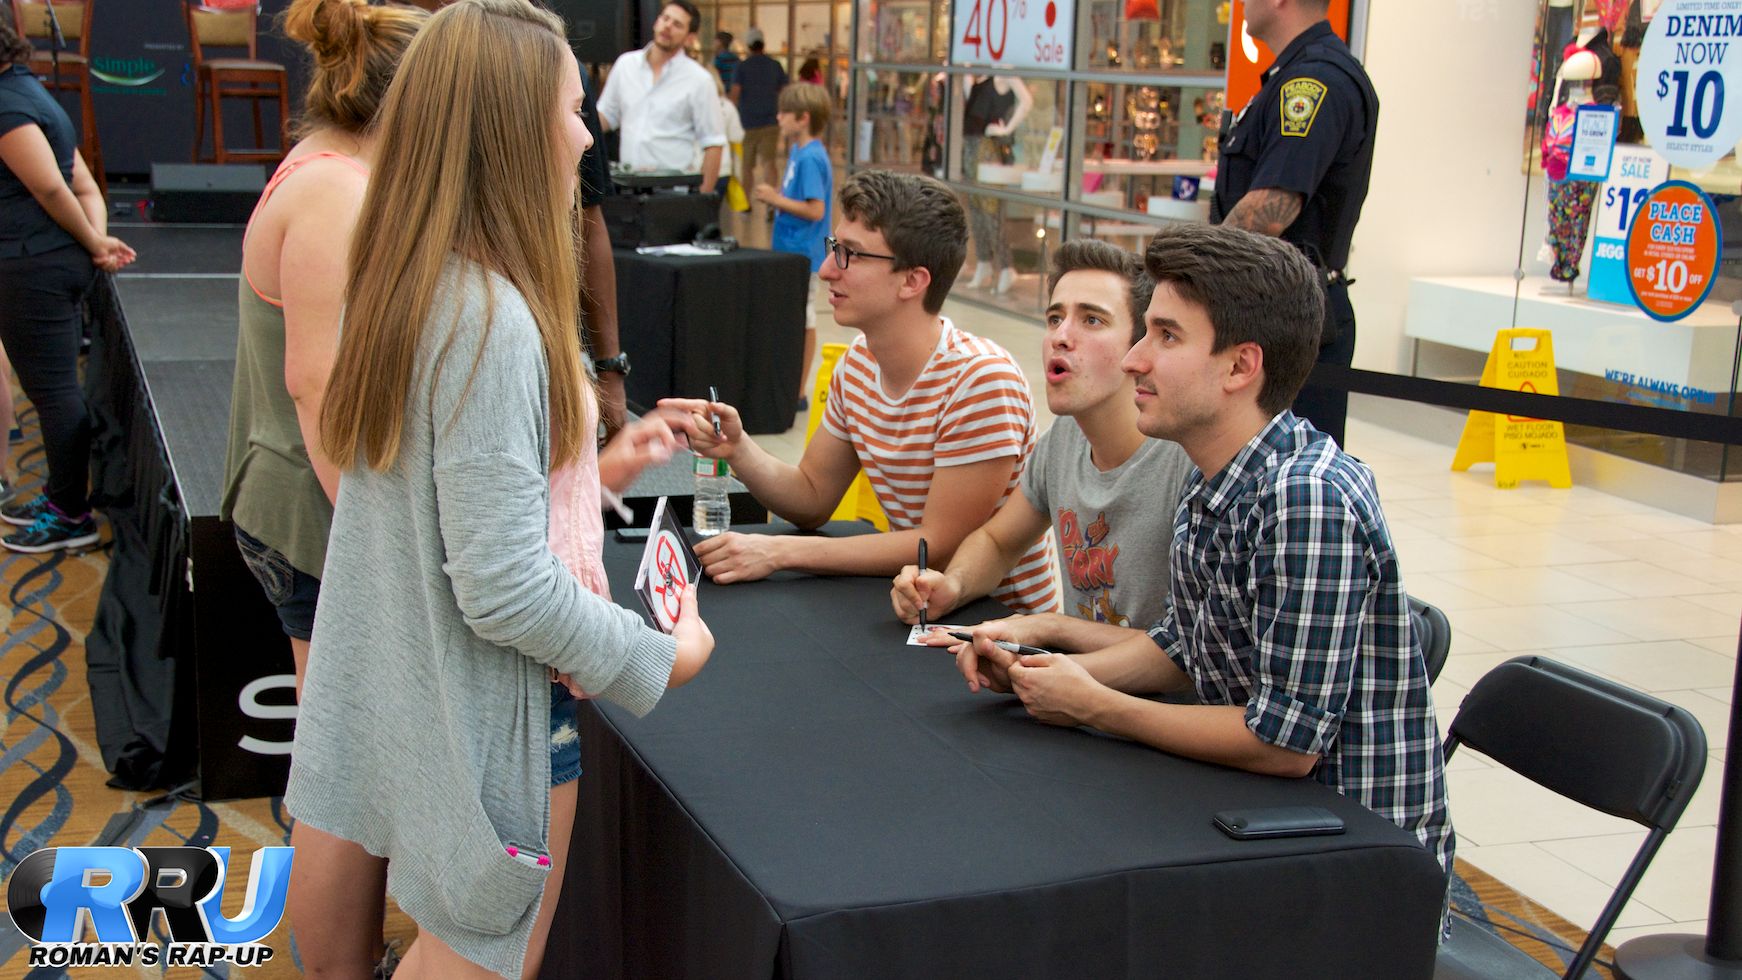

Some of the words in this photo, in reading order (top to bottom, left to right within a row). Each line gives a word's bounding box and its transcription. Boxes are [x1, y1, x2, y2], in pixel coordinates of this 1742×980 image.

[1676, 2, 1702, 10] LIMITED
[1704, 2, 1719, 10] TIME
[1665, 14, 1742, 37] DENIM
[1034, 34, 1063, 63] Sale
[1675, 43, 1728, 64] NOW
[1656, 70, 1725, 139] $10
[1621, 163, 1651, 179] SALE
[1649, 202, 1702, 222] PLACE
[1596, 242, 1625, 260] JEGG
[1634, 266, 1646, 278] GET
[1646, 259, 1688, 294] $10
[1689, 274, 1703, 284] OFF
[1507, 361, 1548, 369] CAUTION
[1507, 370, 1548, 378] CUIDADO
[1604, 368, 1636, 388] WE'RE
[1638, 376, 1679, 397] ALWAYS
[1506, 424, 1524, 432] WET
[1526, 423, 1554, 431] FLOOR
[1524, 432, 1559, 440] MOJADO
[238, 674, 299, 755] S
